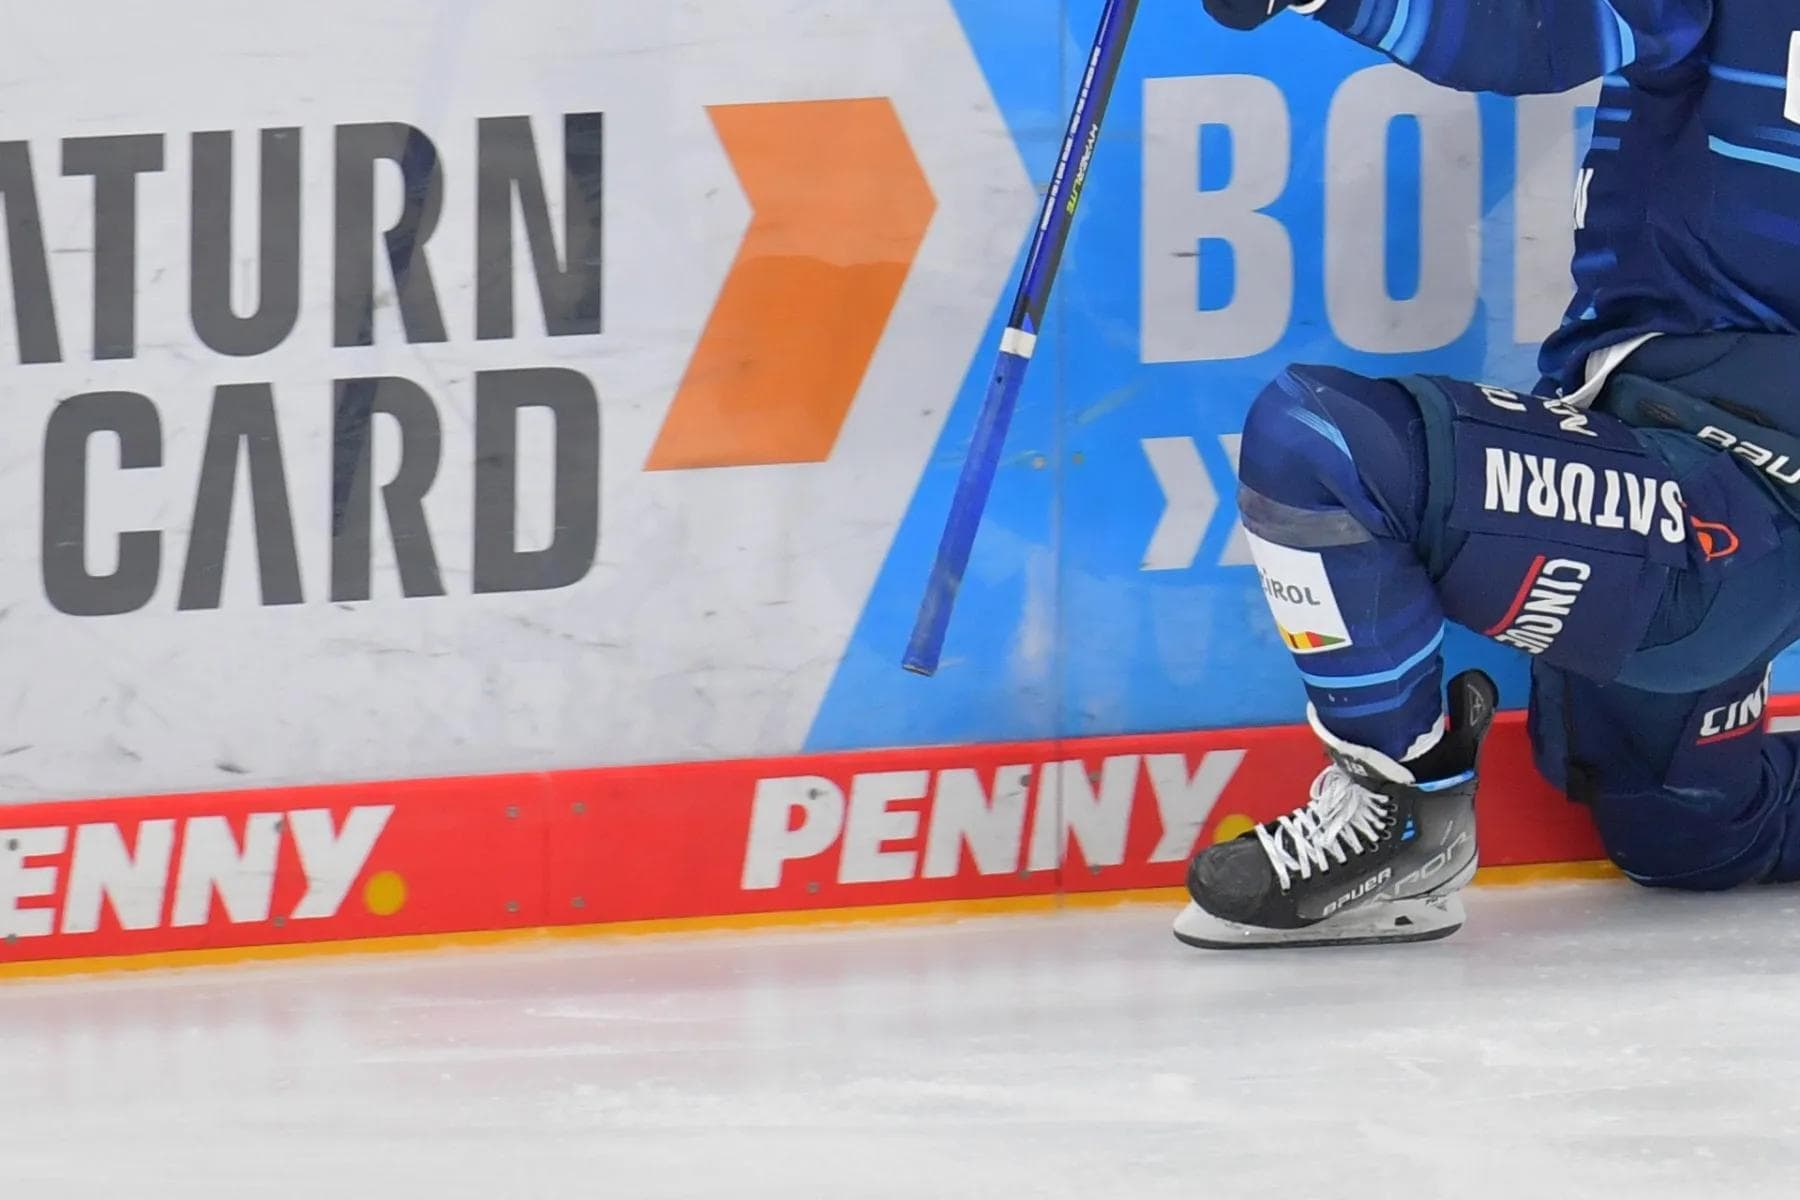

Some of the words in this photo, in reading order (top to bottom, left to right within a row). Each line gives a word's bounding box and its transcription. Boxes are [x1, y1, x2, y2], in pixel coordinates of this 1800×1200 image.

[41, 367, 601, 617] CARD
[1484, 447, 1687, 544] SATURN
[741, 749, 1248, 890] PENNY
